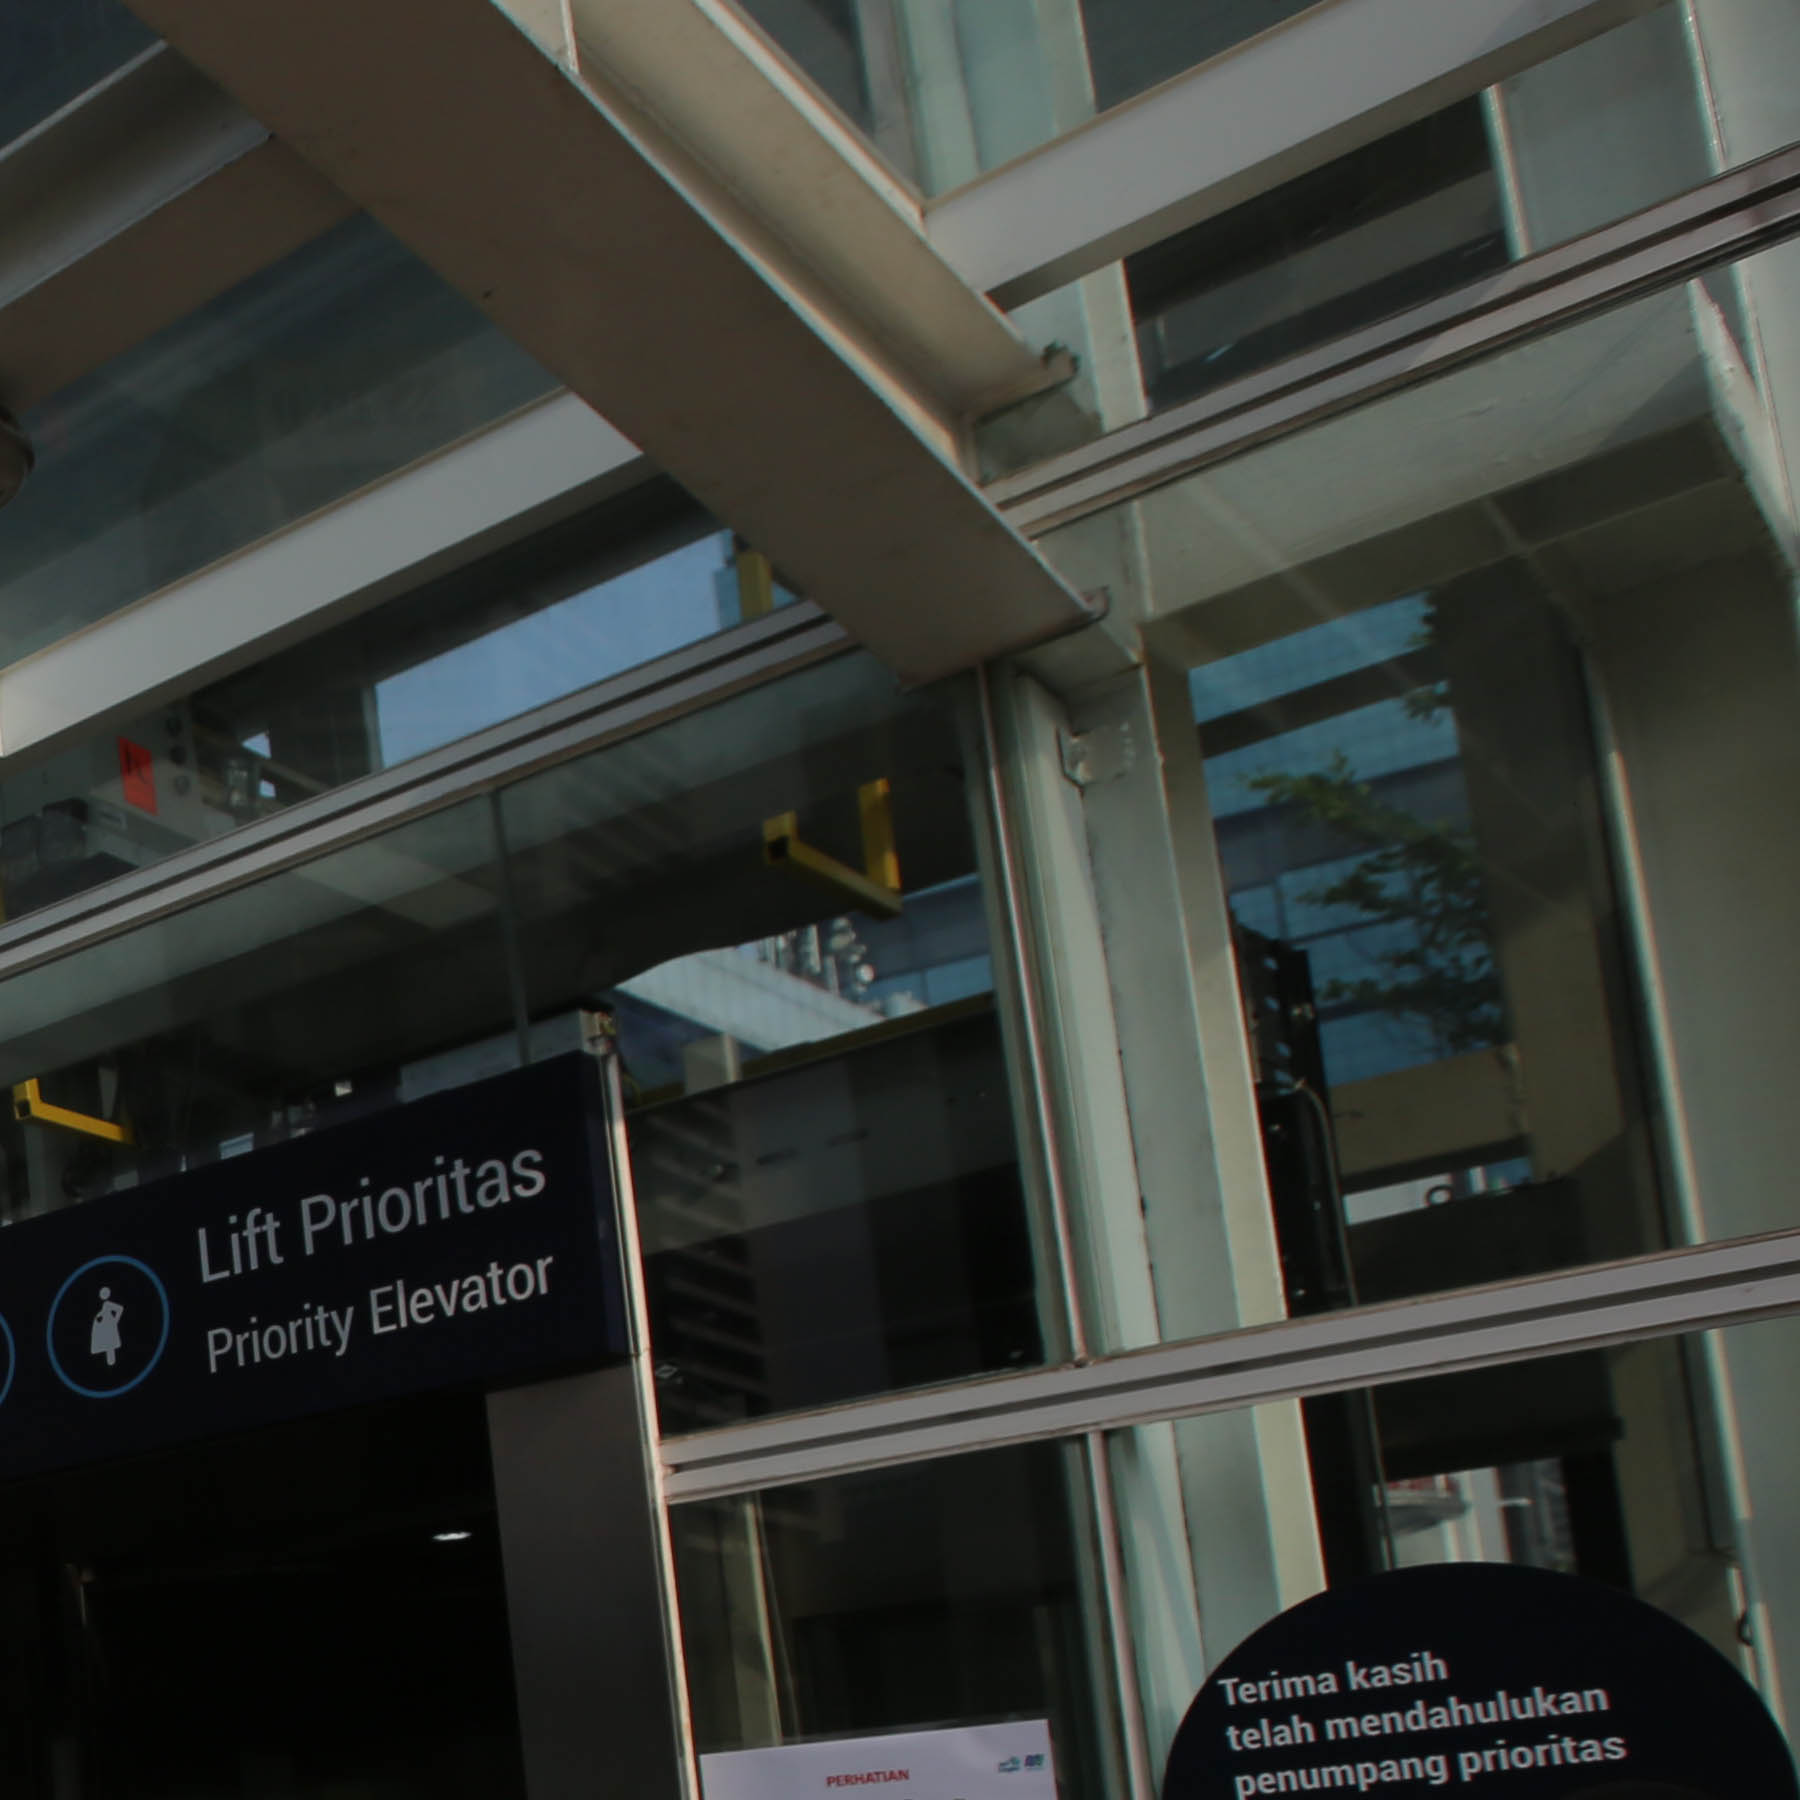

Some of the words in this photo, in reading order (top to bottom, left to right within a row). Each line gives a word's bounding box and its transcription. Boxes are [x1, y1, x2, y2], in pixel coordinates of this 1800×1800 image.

[198, 1208, 283, 1282] Lift
[301, 1150, 545, 1255] Prioritas
[208, 1303, 354, 1373] Priority
[371, 1256, 552, 1334] Elevator
[1218, 1671, 1338, 1705] Terima
[1347, 1652, 1447, 1690] kasih
[1226, 1715, 1315, 1751] telah
[1325, 1687, 1608, 1740] mendahulukan
[826, 1770, 910, 1788] PERHATIAN
[1459, 1734, 1626, 1781] prioritas
